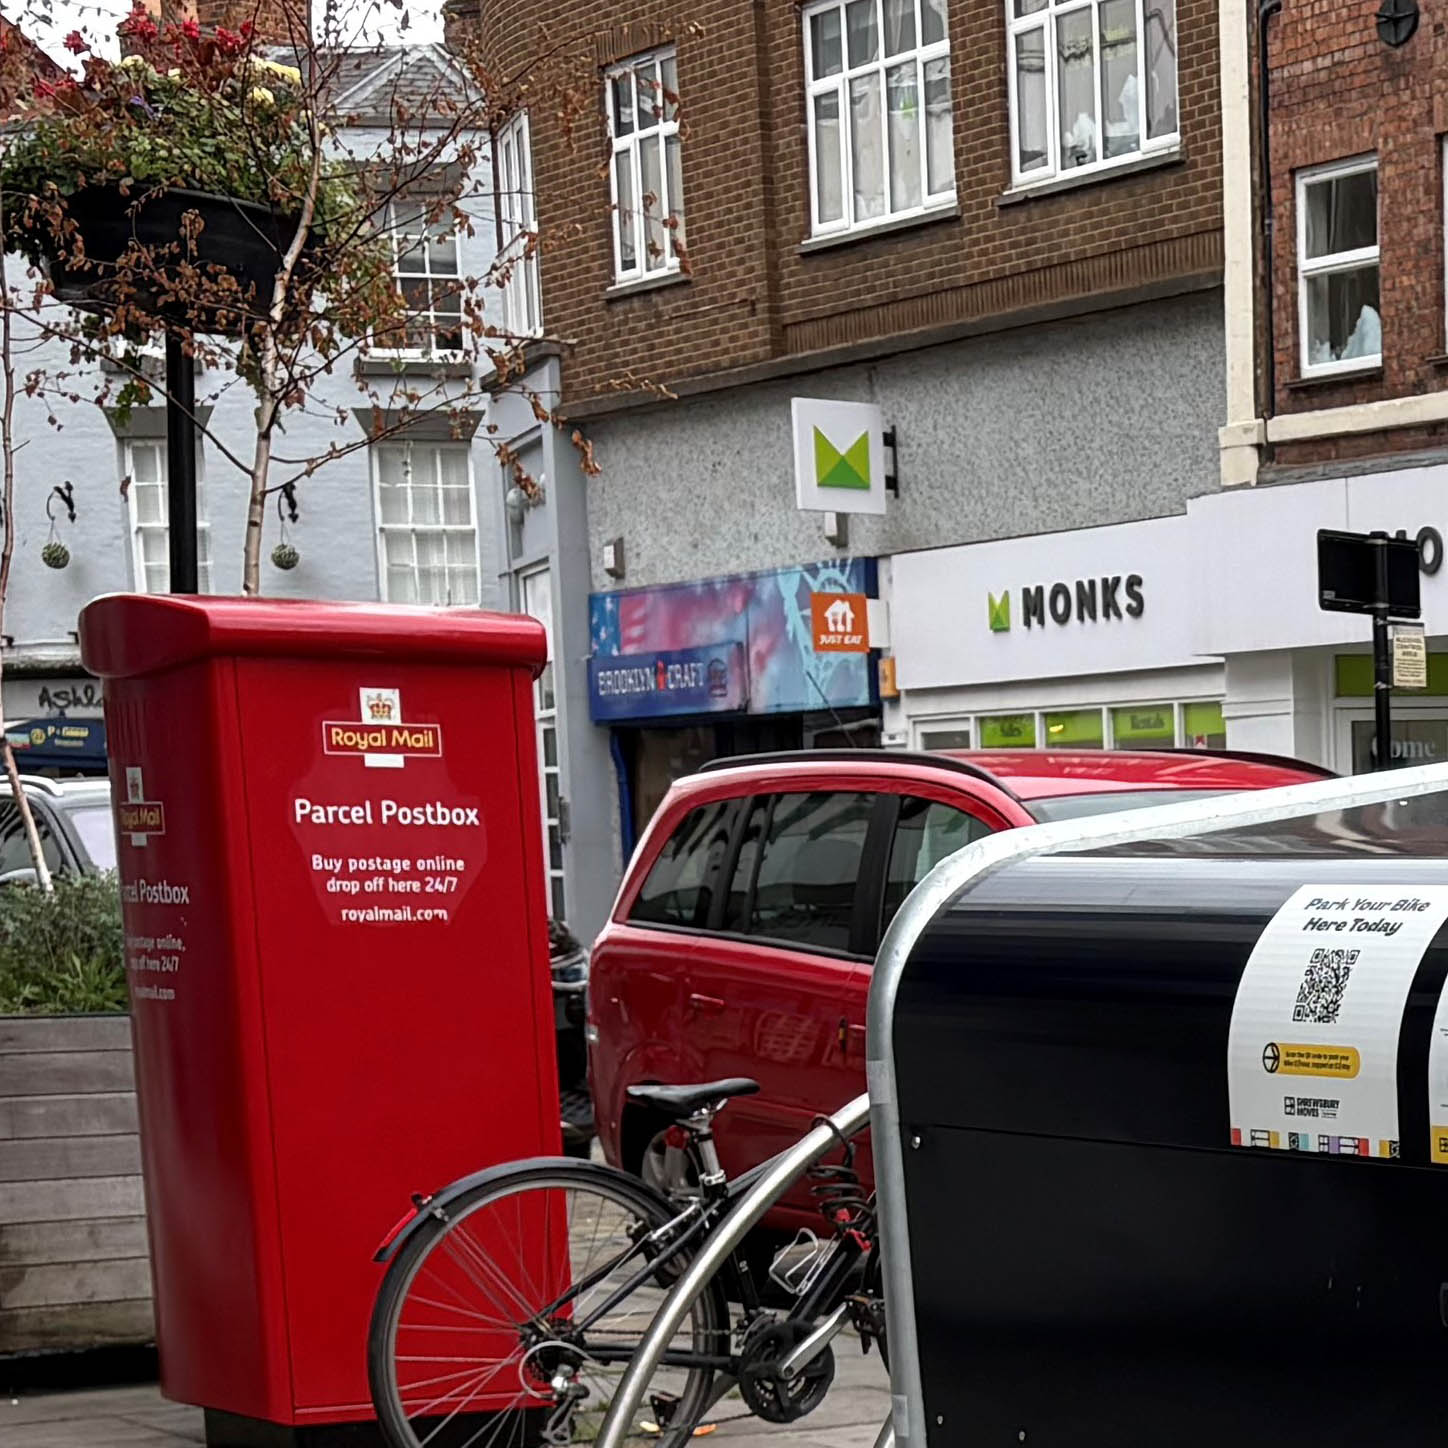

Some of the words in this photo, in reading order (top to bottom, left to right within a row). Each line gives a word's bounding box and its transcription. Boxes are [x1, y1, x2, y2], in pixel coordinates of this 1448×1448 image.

[1021, 573, 1145, 628] MONKS
[819, 634, 841, 645] JUST
[844, 634, 863, 645] EAT
[598, 667, 656, 696] BROOKLYN
[668, 662, 704, 689] CRAFT
[331, 728, 387, 750] Royal
[392, 730, 433, 748] Mail
[294, 799, 373, 825] Parcel
[381, 800, 480, 826] Postbox
[312, 854, 342, 873] Buy
[348, 856, 411, 874] postage
[416, 856, 465, 872] online
[140, 879, 190, 904] Postbox
[326, 876, 360, 895] drop
[364, 877, 385, 892] off
[388, 877, 421, 892] here
[424, 877, 458, 893] 24/7
[341, 906, 448, 923] royalmail.com
[1304, 898, 1346, 911] Park
[1352, 898, 1391, 912] Your
[1390, 899, 1432, 912] Bike
[1303, 918, 1347, 932] Here
[1349, 919, 1403, 936] Today
[1297, 1097, 1340, 1109] SHREWSBURY
[1297, 1108, 1319, 1117] MOVES
